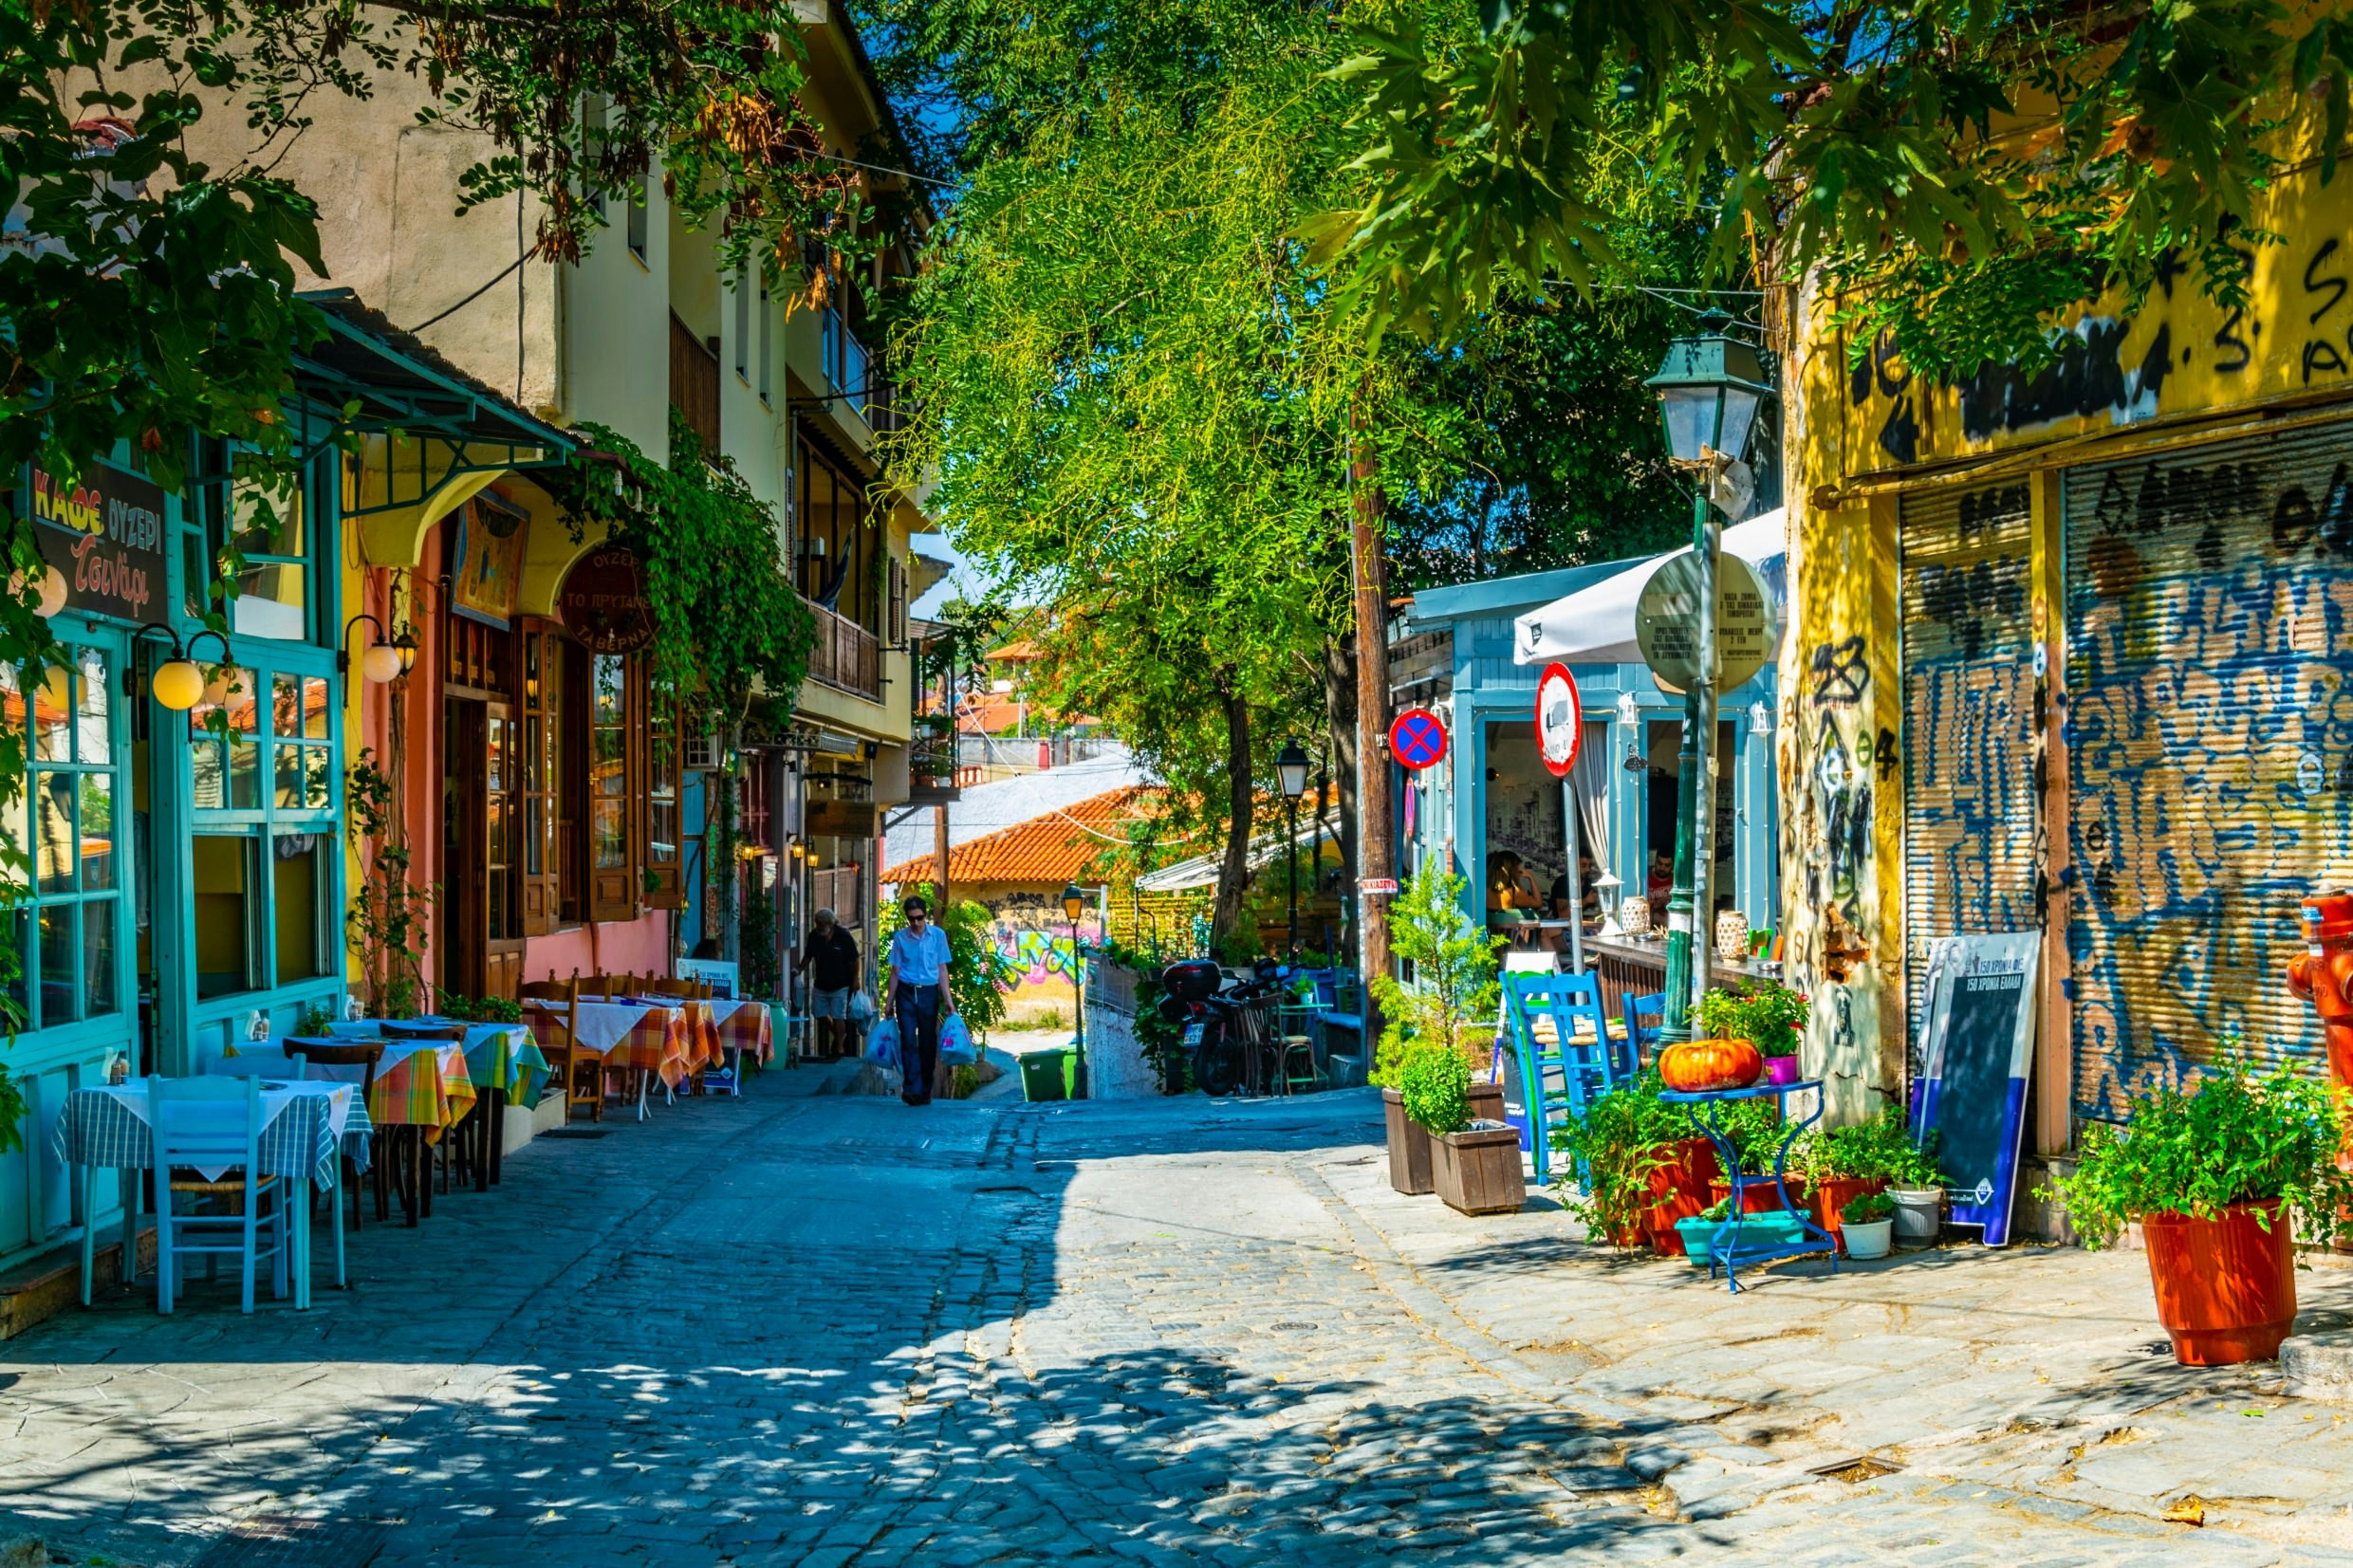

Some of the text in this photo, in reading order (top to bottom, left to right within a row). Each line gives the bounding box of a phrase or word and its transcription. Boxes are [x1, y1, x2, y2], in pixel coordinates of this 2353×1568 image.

[108, 498, 161, 555] ΟΥΖΕΡΙ
[593, 552, 640, 569] ΟΥΖΕΡ
[70, 533, 150, 618] Τσινάρι
[566, 593, 651, 609] ΤΟ ΠΡΥΤΑΝΕ
[576, 624, 649, 652] ΤΑΒΕΡΝΑ
[1980, 960, 1991, 974] 150
[1967, 978, 1978, 992] 150
[1978, 976, 2000, 991] ΧΡΟΝΙΑ
